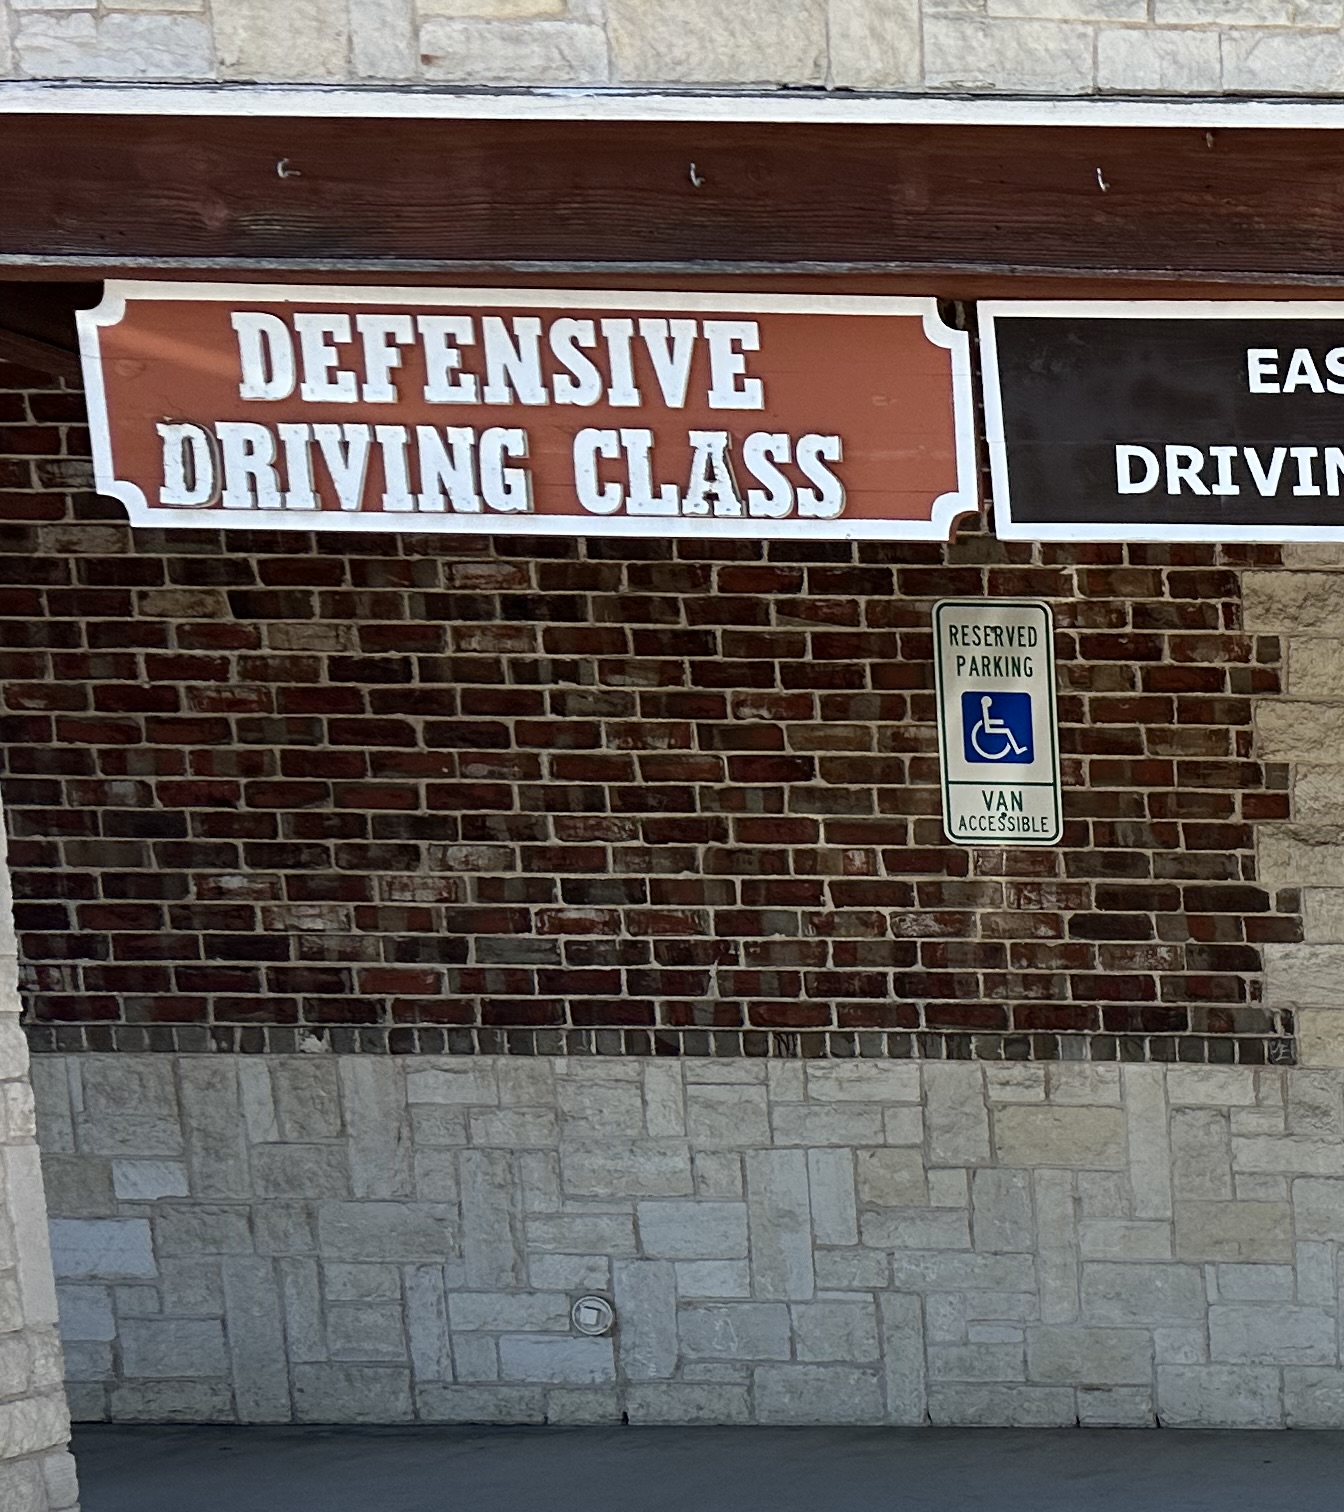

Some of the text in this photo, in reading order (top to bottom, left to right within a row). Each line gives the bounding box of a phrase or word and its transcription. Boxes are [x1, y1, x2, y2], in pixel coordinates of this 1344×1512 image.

[230, 311, 765, 410] DEFENSIVE
[157, 418, 846, 519] DRIVING CLASS
[949, 624, 1037, 648] RESERVED
[957, 655, 1033, 678] PARKING
[982, 790, 1023, 812] VAN
[958, 815, 1049, 833] ACCESSIBLE
